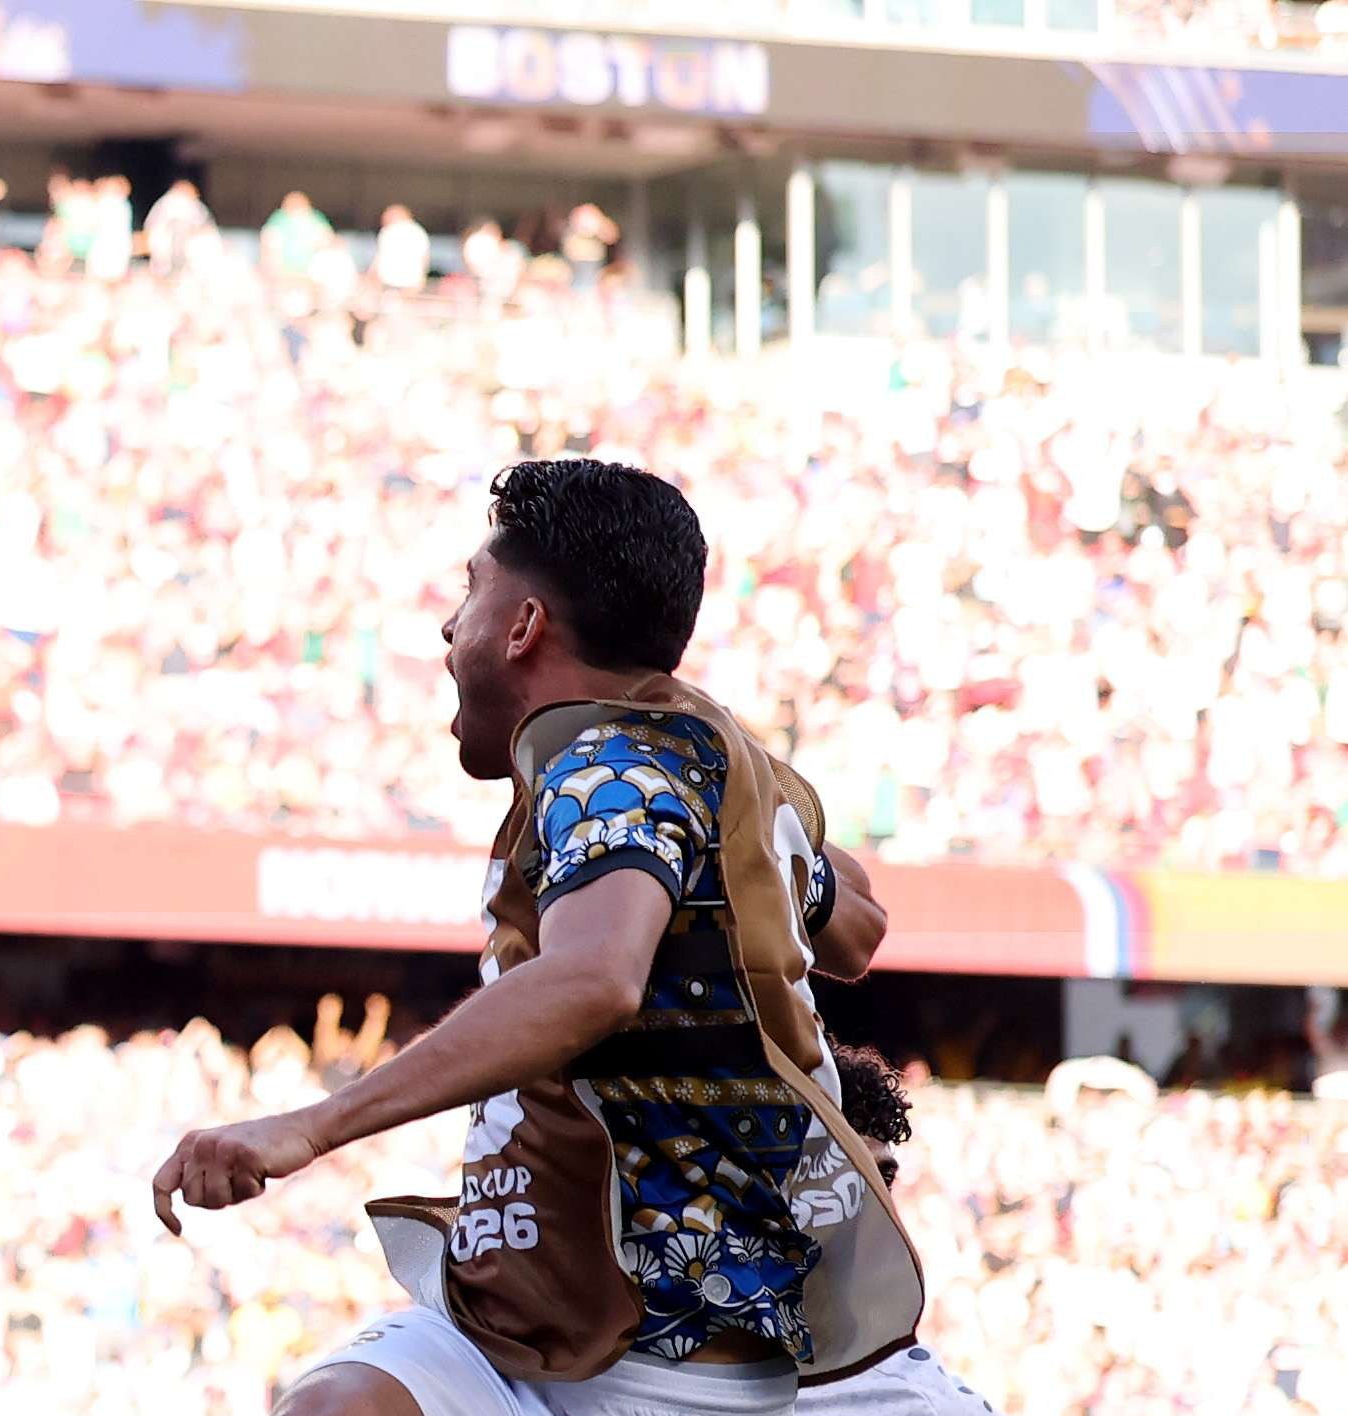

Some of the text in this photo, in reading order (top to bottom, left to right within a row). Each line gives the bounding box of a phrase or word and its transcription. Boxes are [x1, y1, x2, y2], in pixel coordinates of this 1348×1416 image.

[447, 24, 768, 115] BOSTON
[481, 1165, 533, 1200] CUP
[450, 1201, 540, 1263] 026
